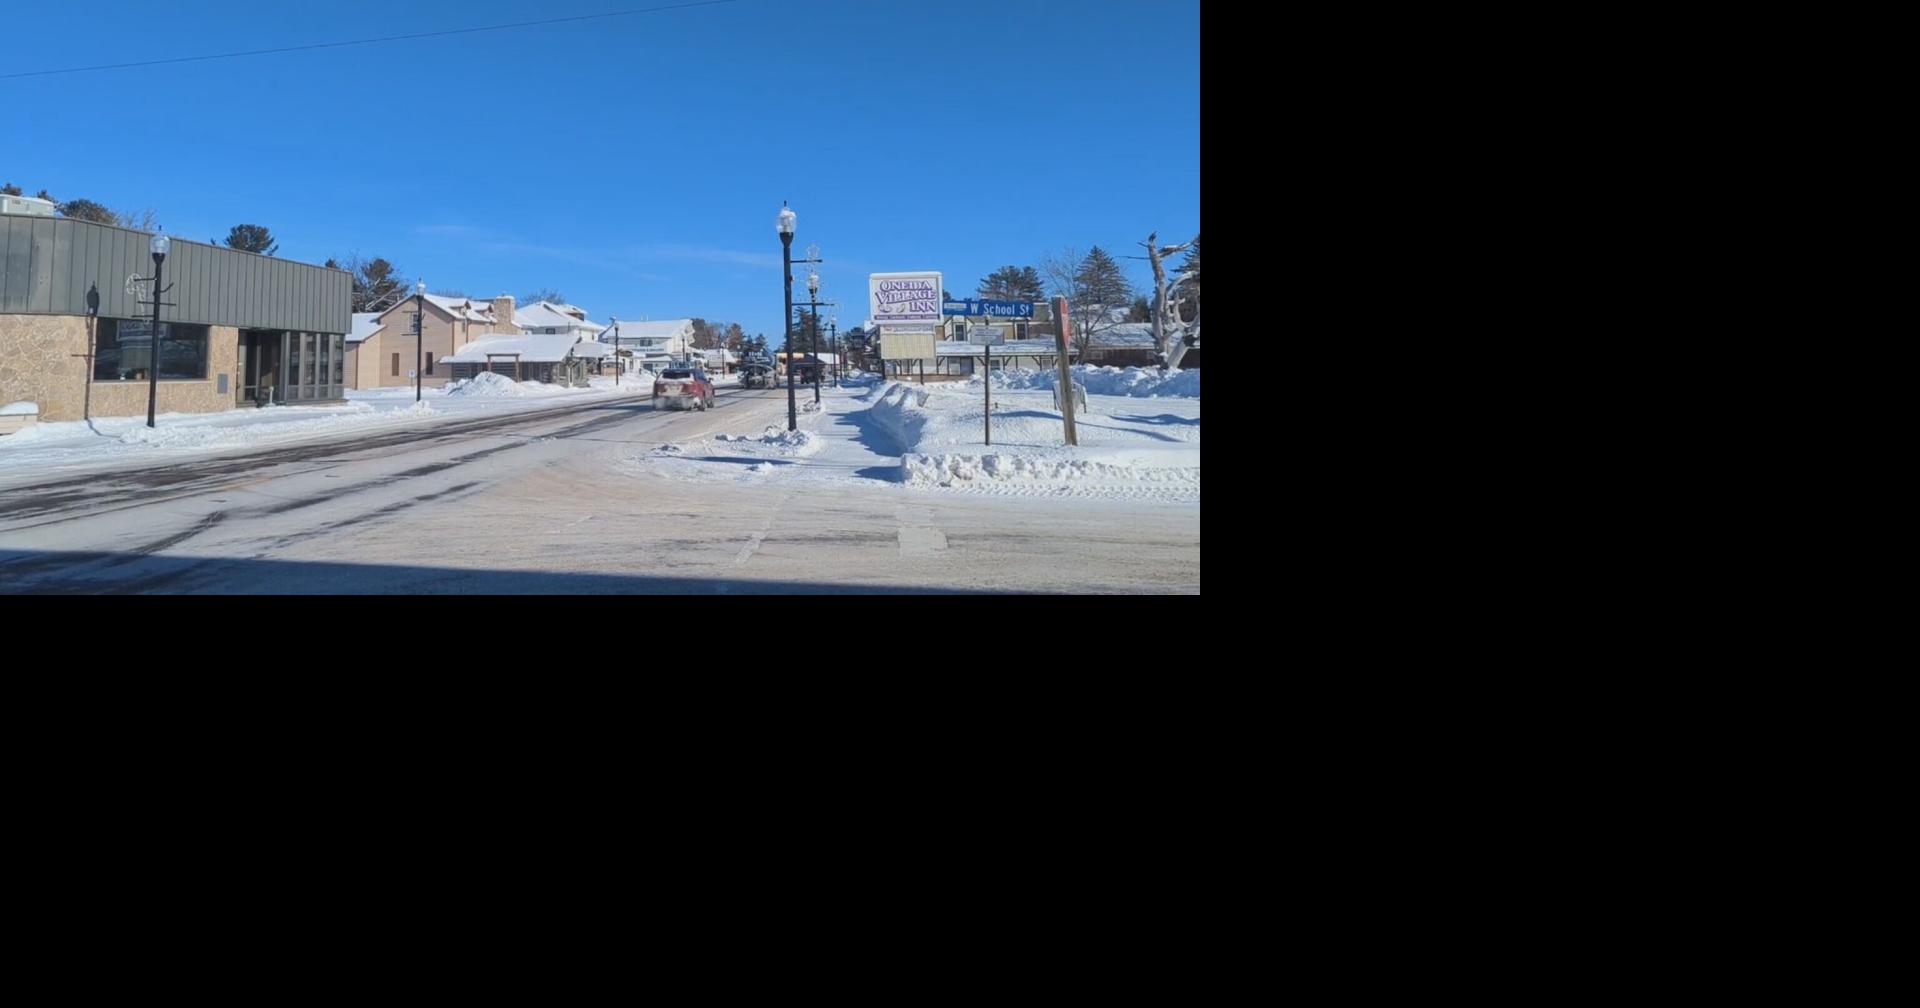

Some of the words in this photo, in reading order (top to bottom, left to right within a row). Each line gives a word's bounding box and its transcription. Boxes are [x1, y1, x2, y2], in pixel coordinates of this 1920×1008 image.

[880, 280, 932, 292] ONEIDA
[875, 290, 936, 304] VILLAGE
[909, 301, 936, 313] INN
[970, 302, 978, 314] W
[983, 303, 1015, 315] School
[1020, 304, 1030, 315] St
